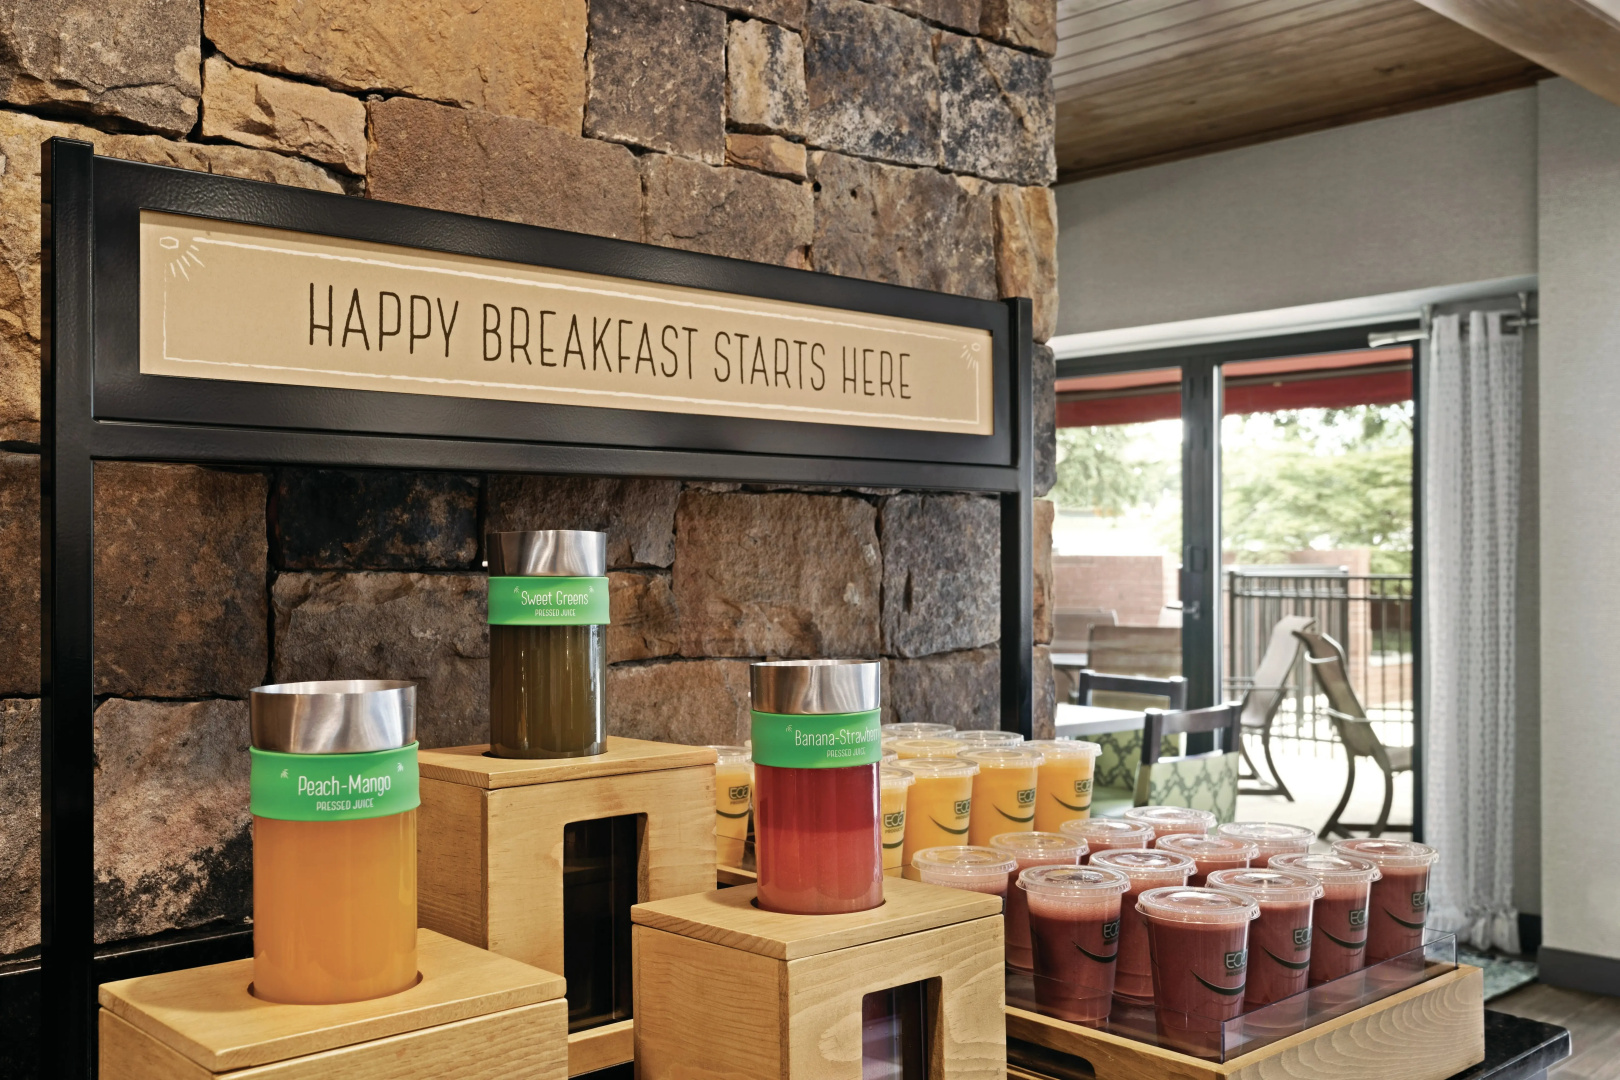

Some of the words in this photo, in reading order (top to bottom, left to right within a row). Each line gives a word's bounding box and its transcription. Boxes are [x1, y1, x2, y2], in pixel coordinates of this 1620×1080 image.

[309, 282, 459, 358] HAPPY
[482, 302, 699, 380] BREAKFAST
[714, 331, 826, 391] STARTS
[842, 345, 912, 400] HERE
[521, 591, 552, 606] Sweet
[556, 591, 589, 606] Greens
[534, 608, 559, 616] PRESSED
[560, 608, 576, 616] JUICE
[826, 748, 852, 758] PRESSED
[852, 746, 866, 757] JUICE
[298, 774, 391, 797] Peach-Mango
[316, 800, 351, 811] PRESSED
[352, 797, 374, 809] JUICE
